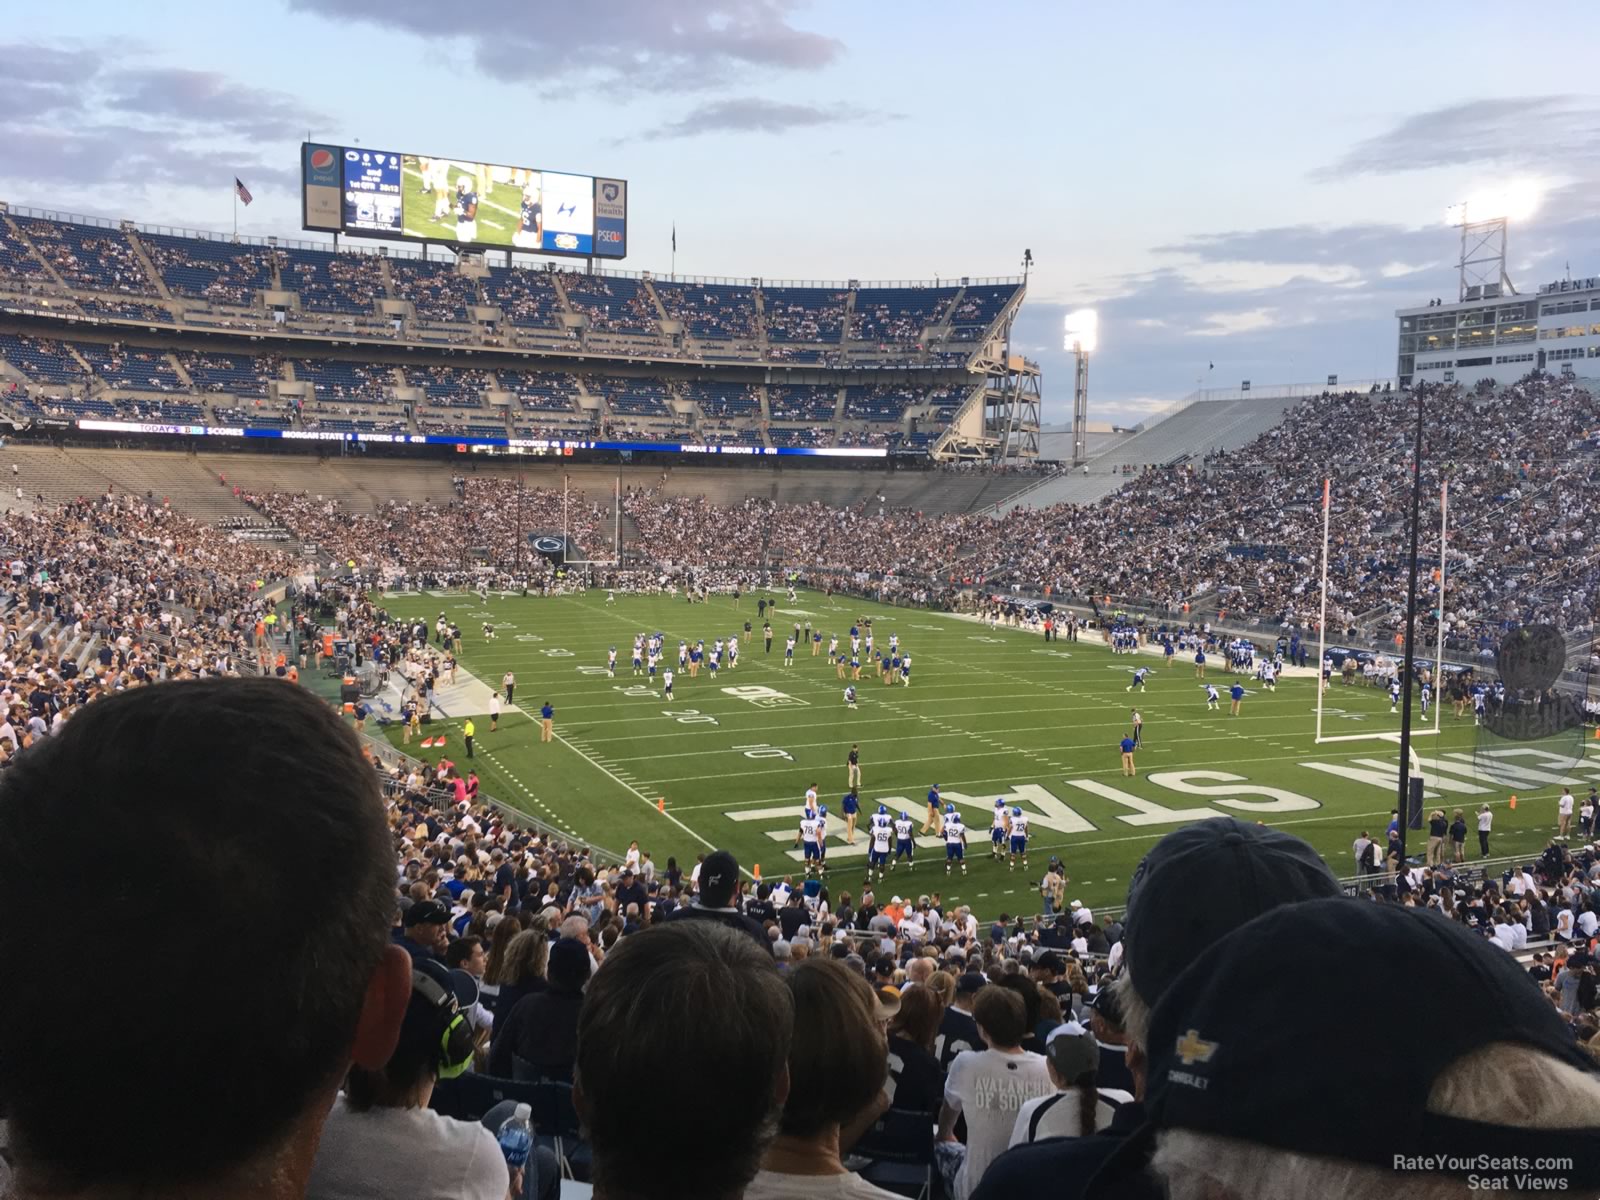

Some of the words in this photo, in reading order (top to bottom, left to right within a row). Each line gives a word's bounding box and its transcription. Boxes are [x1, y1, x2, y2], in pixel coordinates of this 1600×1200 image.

[598, 207, 623, 216] Health
[1548, 278, 1594, 294] PENN
[140, 424, 179, 433] TODAY'S
[207, 427, 244, 436] SCORES
[282, 430, 319, 440] MORGAN
[320, 432, 345, 441] STATE
[358, 433, 393, 442] RUTGERS
[410, 436, 426, 444] 4TH
[508, 439, 549, 448] WISCONSIN
[564, 441, 579, 449] BYU
[681, 444, 707, 453] PURDUE
[721, 445, 754, 454] MISSOURI
[661, 708, 717, 725] 20
[731, 743, 790, 760] 10
[876, 832, 888, 841] 65
[948, 828, 959, 837] 62
[975, 1092, 994, 1110] OF
